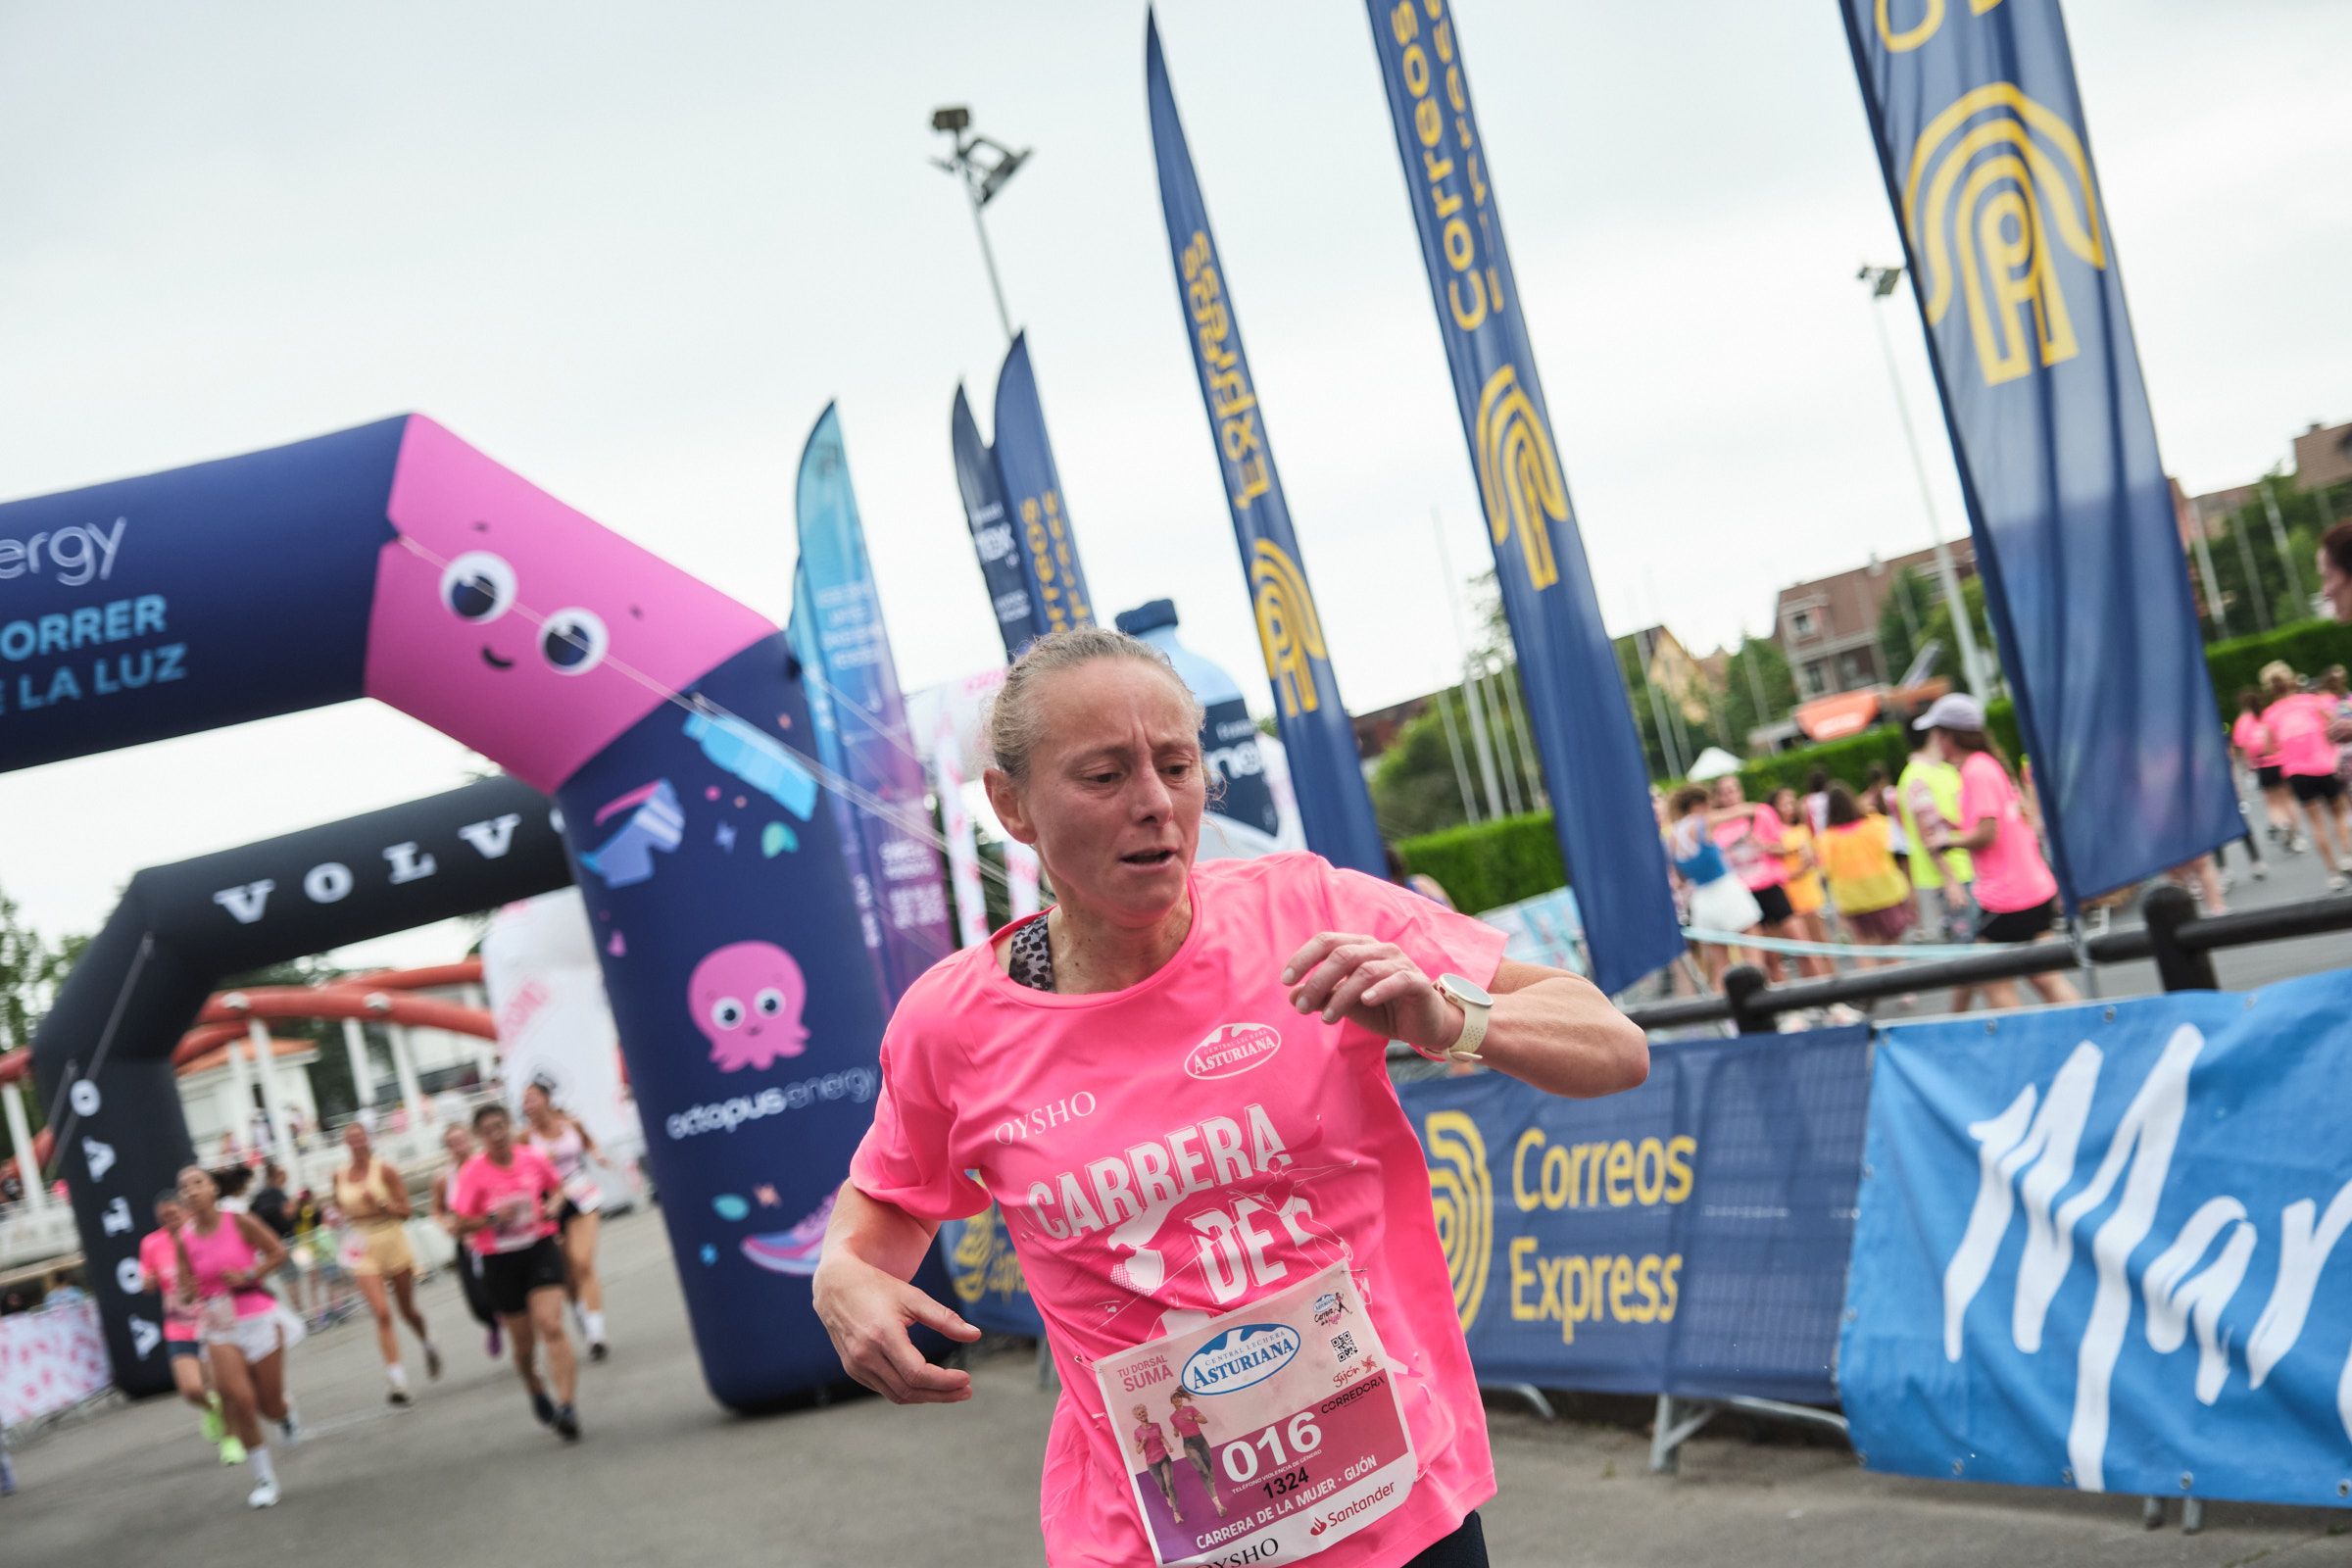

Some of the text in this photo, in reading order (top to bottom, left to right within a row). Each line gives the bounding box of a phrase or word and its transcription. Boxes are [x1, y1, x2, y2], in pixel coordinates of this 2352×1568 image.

[0, 593, 168, 662] ORRER
[19, 664, 82, 710] LA
[93, 641, 188, 696] LUZ
[214, 807, 565, 924] VOLV
[1194, 1035, 1276, 1075] ASTURIANA
[995, 1090, 1097, 1146] OYSHO
[1027, 1102, 1295, 1240] CARRERA
[1511, 1127, 1697, 1212] Correos
[70, 1078, 162, 1361] VOLVO
[1185, 1193, 1290, 1305] DE
[1508, 1235, 1684, 1345] Express
[1117, 1354, 1168, 1378] TU DORSAL
[1123, 1364, 1174, 1392] SUMA
[1194, 1338, 1295, 1390] ASTURIANA
[1204, 1330, 1286, 1366] CENTRAL LECHERA
[1221, 1411, 1322, 1483] 016
[1262, 1464, 1293, 1481] VIOLENCIA
[1292, 1459, 1300, 1468] DE
[1196, 1454, 1378, 1549] CARRERA DE LA MUJER GIJÓN
[1263, 1466, 1309, 1499] 1324
[1328, 1481, 1396, 1528] Santander
